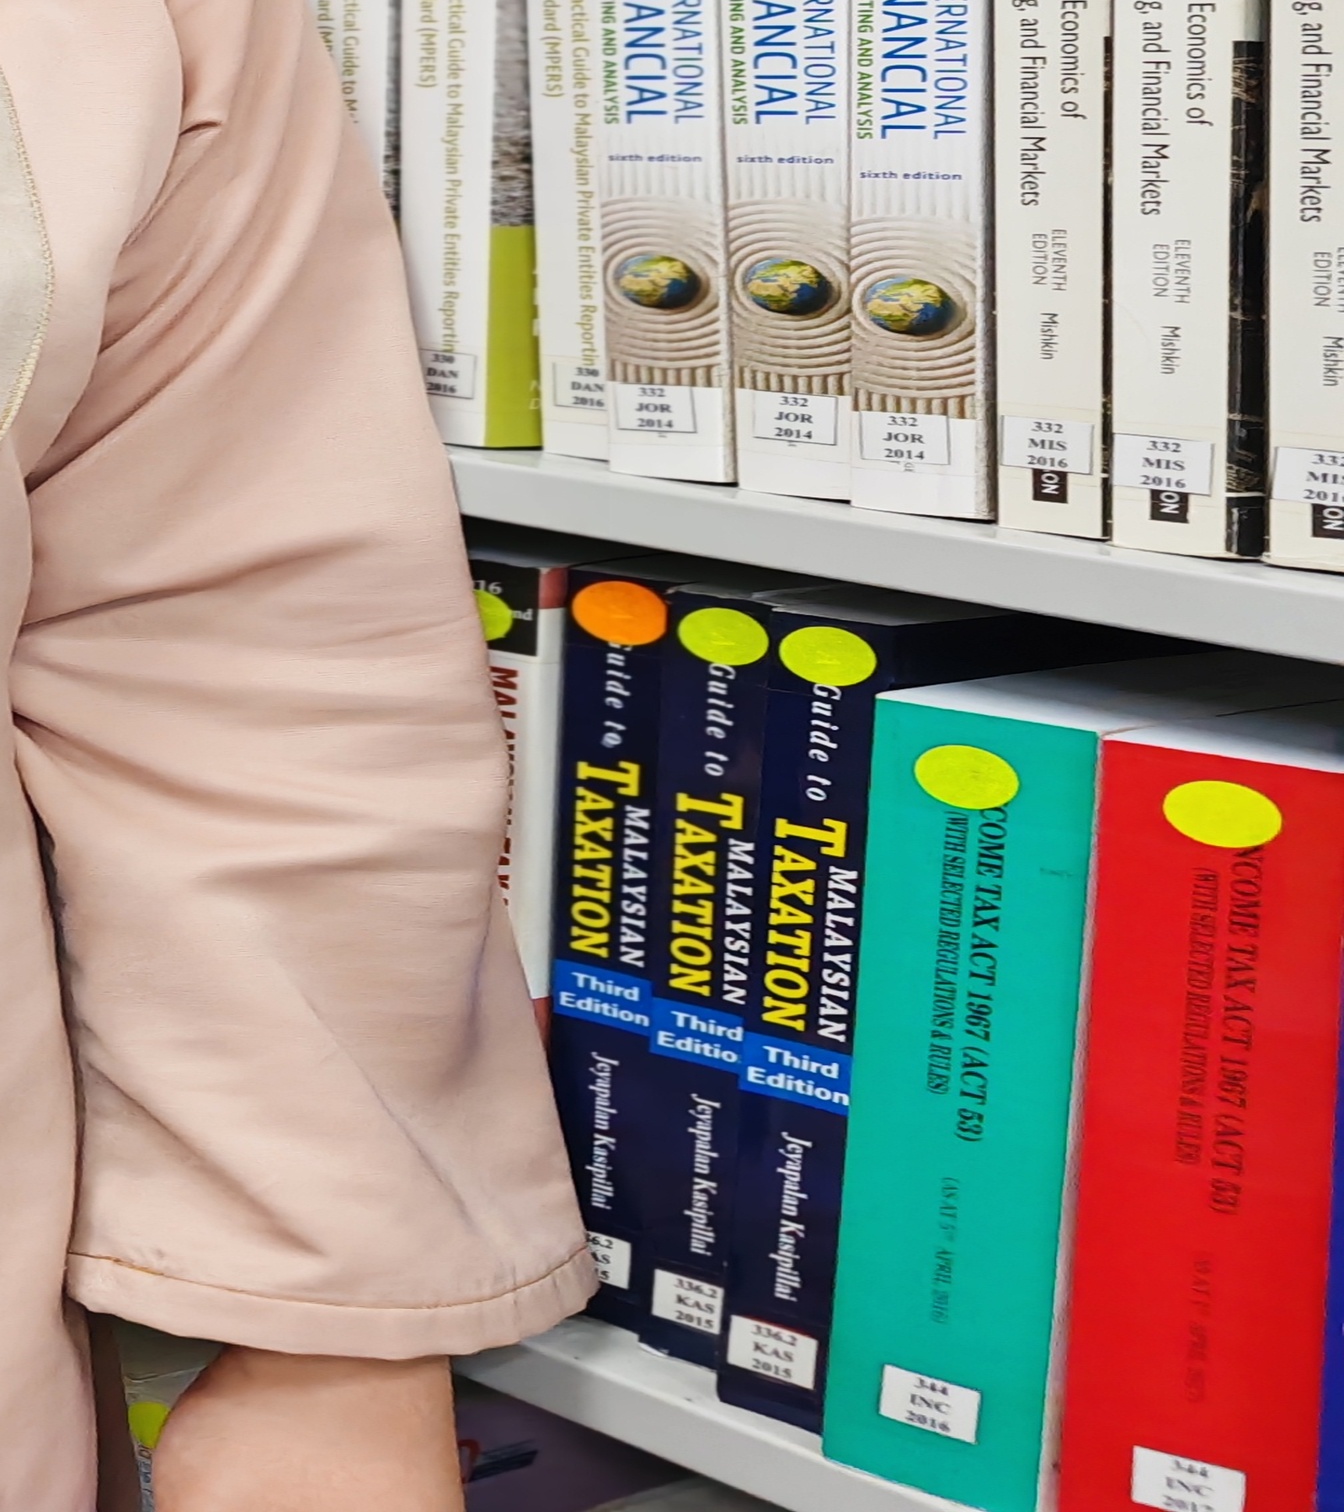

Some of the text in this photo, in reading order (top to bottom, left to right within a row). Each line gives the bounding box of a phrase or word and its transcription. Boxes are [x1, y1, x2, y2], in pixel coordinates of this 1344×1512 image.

[445, 38, 467, 81] Guide
[600, 27, 617, 57] AND
[728, 24, 747, 56] AND
[1019, 16, 1048, 50] and
[1299, 21, 1334, 57] and
[571, 47, 591, 90] Guide
[601, 58, 621, 126] ANALYSIS
[729, 56, 749, 126] ANALYSIS
[1018, 55, 1048, 130] Financial
[1299, 62, 1334, 142] Financial
[902, 169, 964, 182] edition
[1018, 135, 1048, 208] Markets
[1139, 142, 1171, 217] Markets
[1298, 147, 1333, 223] Markets
[443, 178, 463, 230] Private
[576, 188, 595, 242] Private
[442, 233, 462, 287] Entities
[578, 244, 599, 302] Entities
[1031, 232, 1049, 287] EDITION
[1312, 250, 1333, 308] EDITION
[1039, 311, 1060, 361] Mishkin
[1322, 335, 1344, 388] Mishkin
[633, 401, 673, 415] JOR
[637, 386, 667, 398] 332
[773, 410, 815, 425] JOR
[778, 395, 810, 409] 332
[636, 417, 675, 430] 2014
[1027, 437, 1069, 452] MIS
[1030, 420, 1064, 434] 332
[1026, 454, 1069, 470] 2016
[704, 662, 737, 777] Guide to
[808, 683, 842, 763] Guide
[569, 760, 641, 958] TAXATION
[619, 804, 651, 968] MALAYSIAN
[669, 792, 745, 997] TAXATION
[722, 837, 756, 1006] MALAYSIAN
[761, 817, 848, 1032] TAXATION
[931, 853, 966, 1030] SELECTED REGULATIONS
[816, 865, 858, 1043] MALAYSIAN
[559, 990, 650, 1027] Edition
[570, 971, 640, 1002] Third
[670, 1010, 744, 1043] Third
[954, 885, 1003, 1144] TAX ACT 1967 (ACT 53)
[746, 1065, 850, 1107] Edition
[762, 1044, 839, 1080] Third
[1211, 942, 1260, 1176] TAX ACT (ACT
[584, 1051, 620, 1210] Jeyapalan Kasipillai
[683, 1176, 718, 1257] Kasipillai
[768, 1219, 805, 1302] Kasipillai
[751, 1341, 794, 1363] KAS
